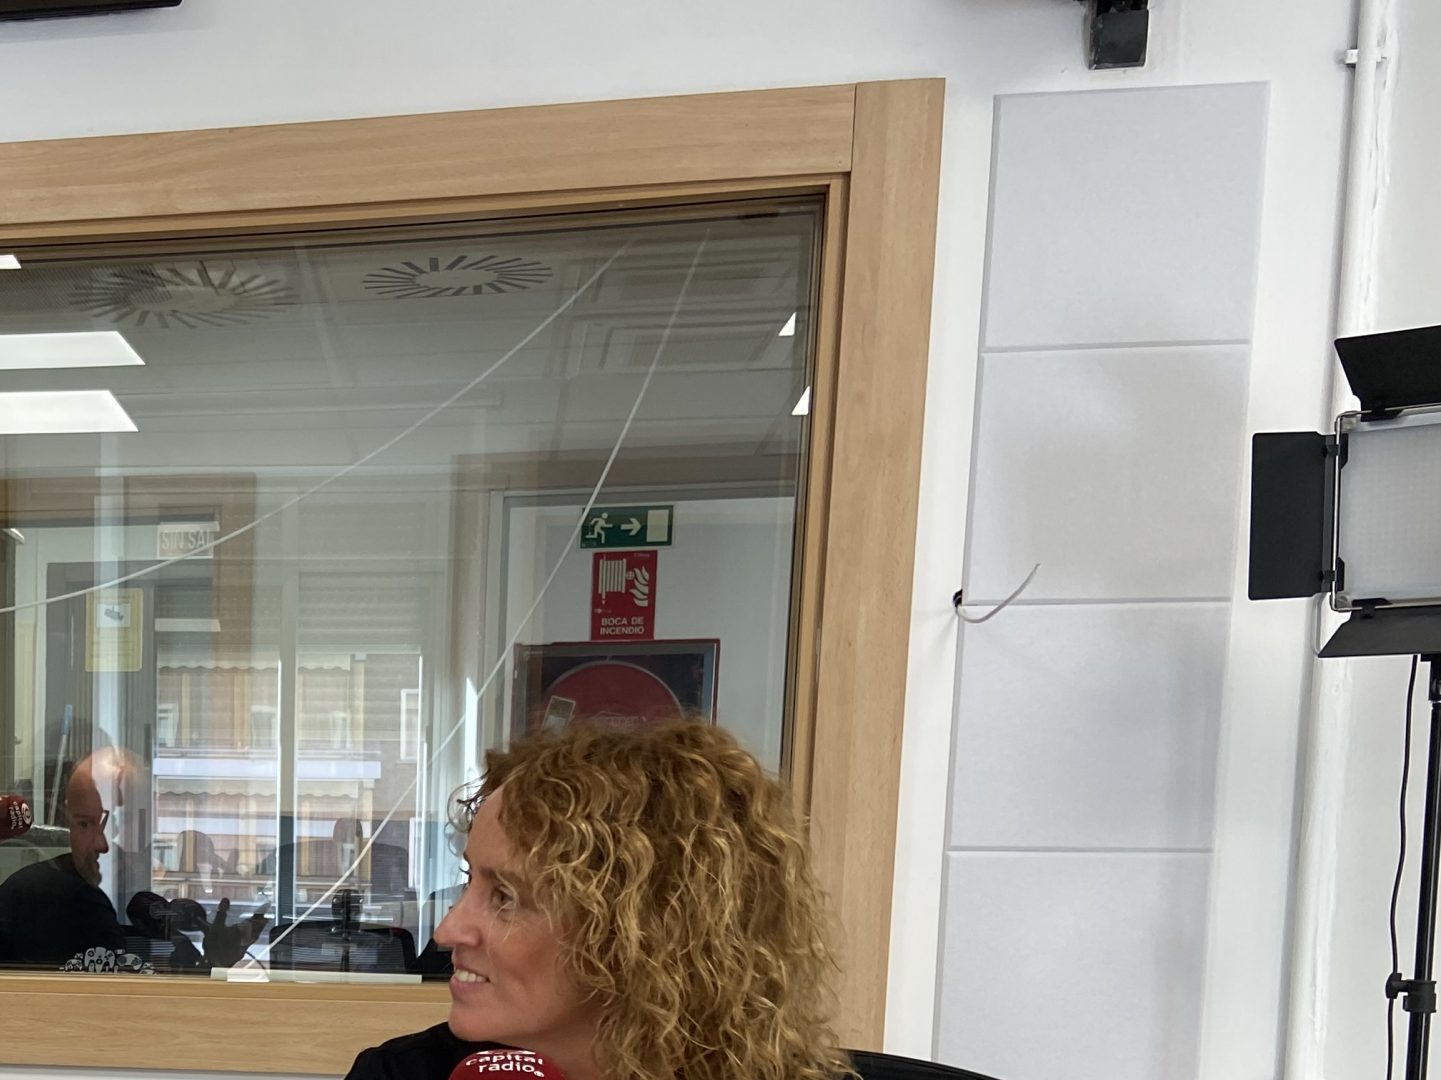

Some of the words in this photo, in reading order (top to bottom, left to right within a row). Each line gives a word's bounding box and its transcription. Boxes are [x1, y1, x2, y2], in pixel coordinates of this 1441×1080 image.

[601, 617, 628, 626] BOCA
[631, 616, 644, 625] DE
[600, 626, 645, 635] INCENDIO
[12, 801, 24, 829] capital
[465, 1054, 544, 1066] capital
[478, 1060, 535, 1073] radio
